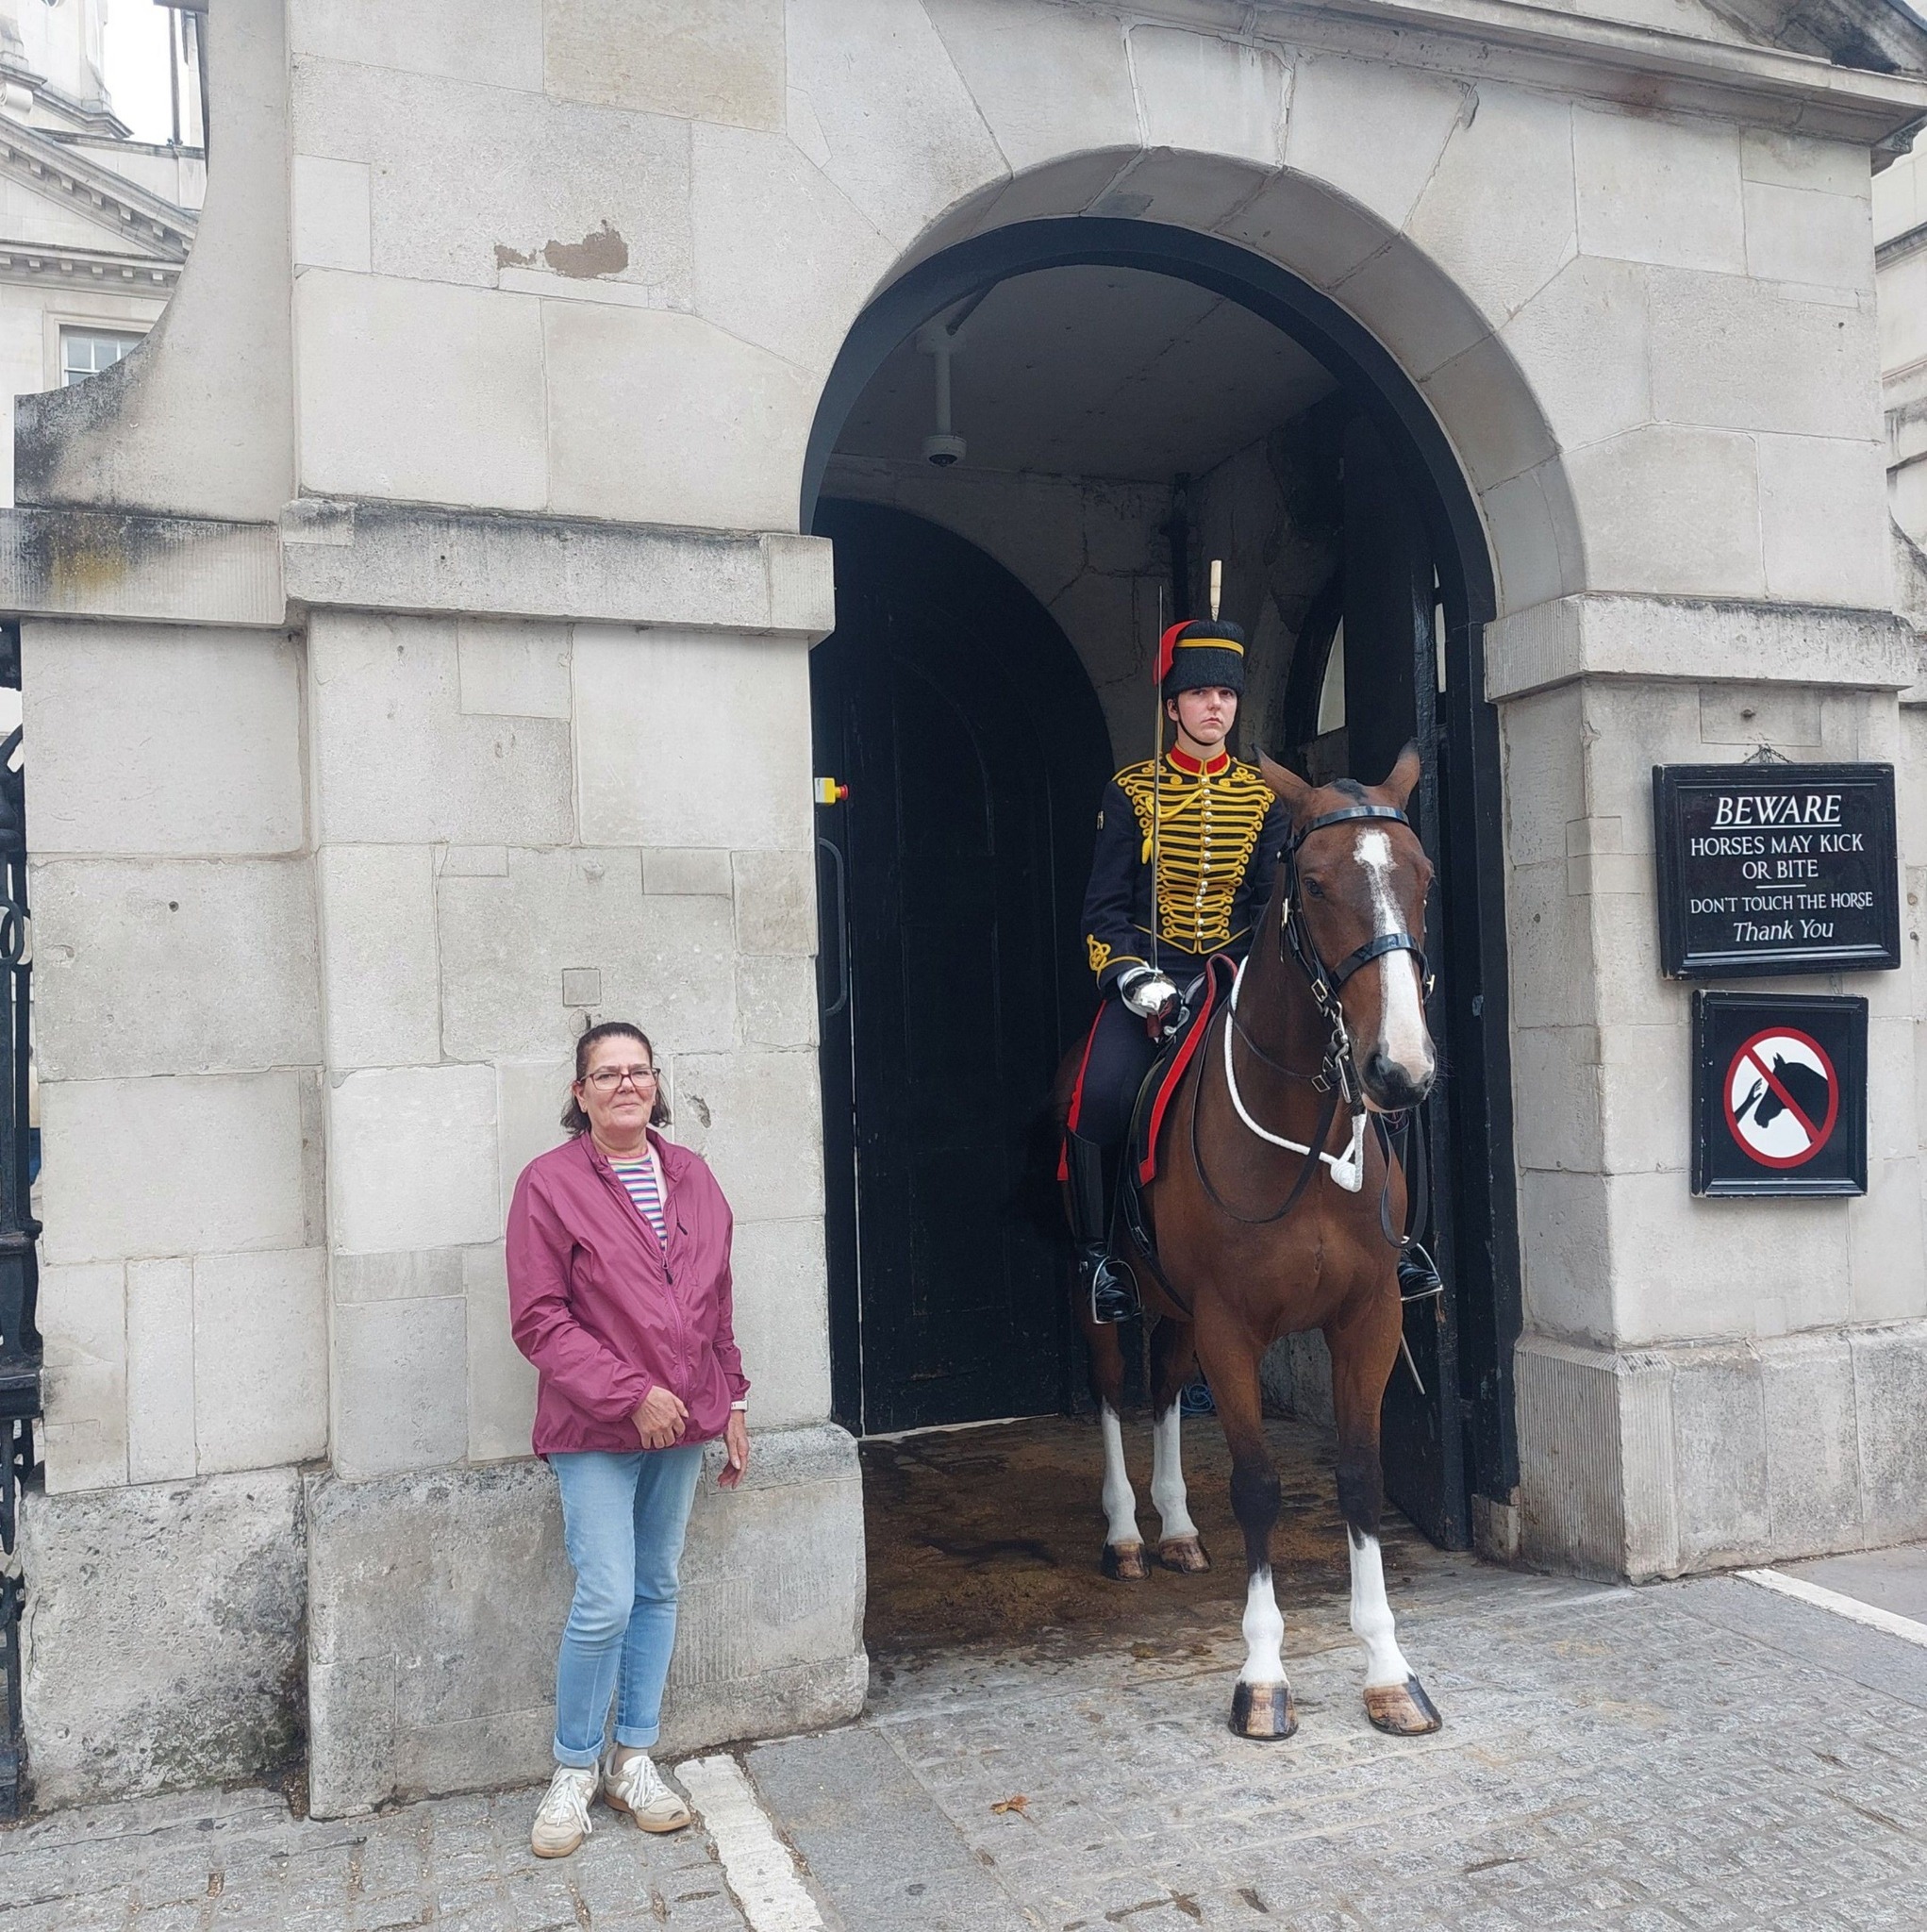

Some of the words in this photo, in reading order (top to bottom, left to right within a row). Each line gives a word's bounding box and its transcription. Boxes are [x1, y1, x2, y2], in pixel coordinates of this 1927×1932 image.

[1715, 795, 1842, 824] BEWARE
[1691, 837, 1764, 856] HORSES
[1771, 835, 1813, 854] MAY
[1819, 834, 1864, 852] KICK
[1742, 861, 1771, 879] OR
[1777, 859, 1819, 878] BITE
[1691, 897, 1737, 913] DON'T
[1741, 895, 1792, 911] TOUCH
[1797, 894, 1826, 910] THE
[1831, 891, 1873, 909] HORSE
[1734, 920, 1794, 941] Thank
[1800, 919, 1834, 938] You
